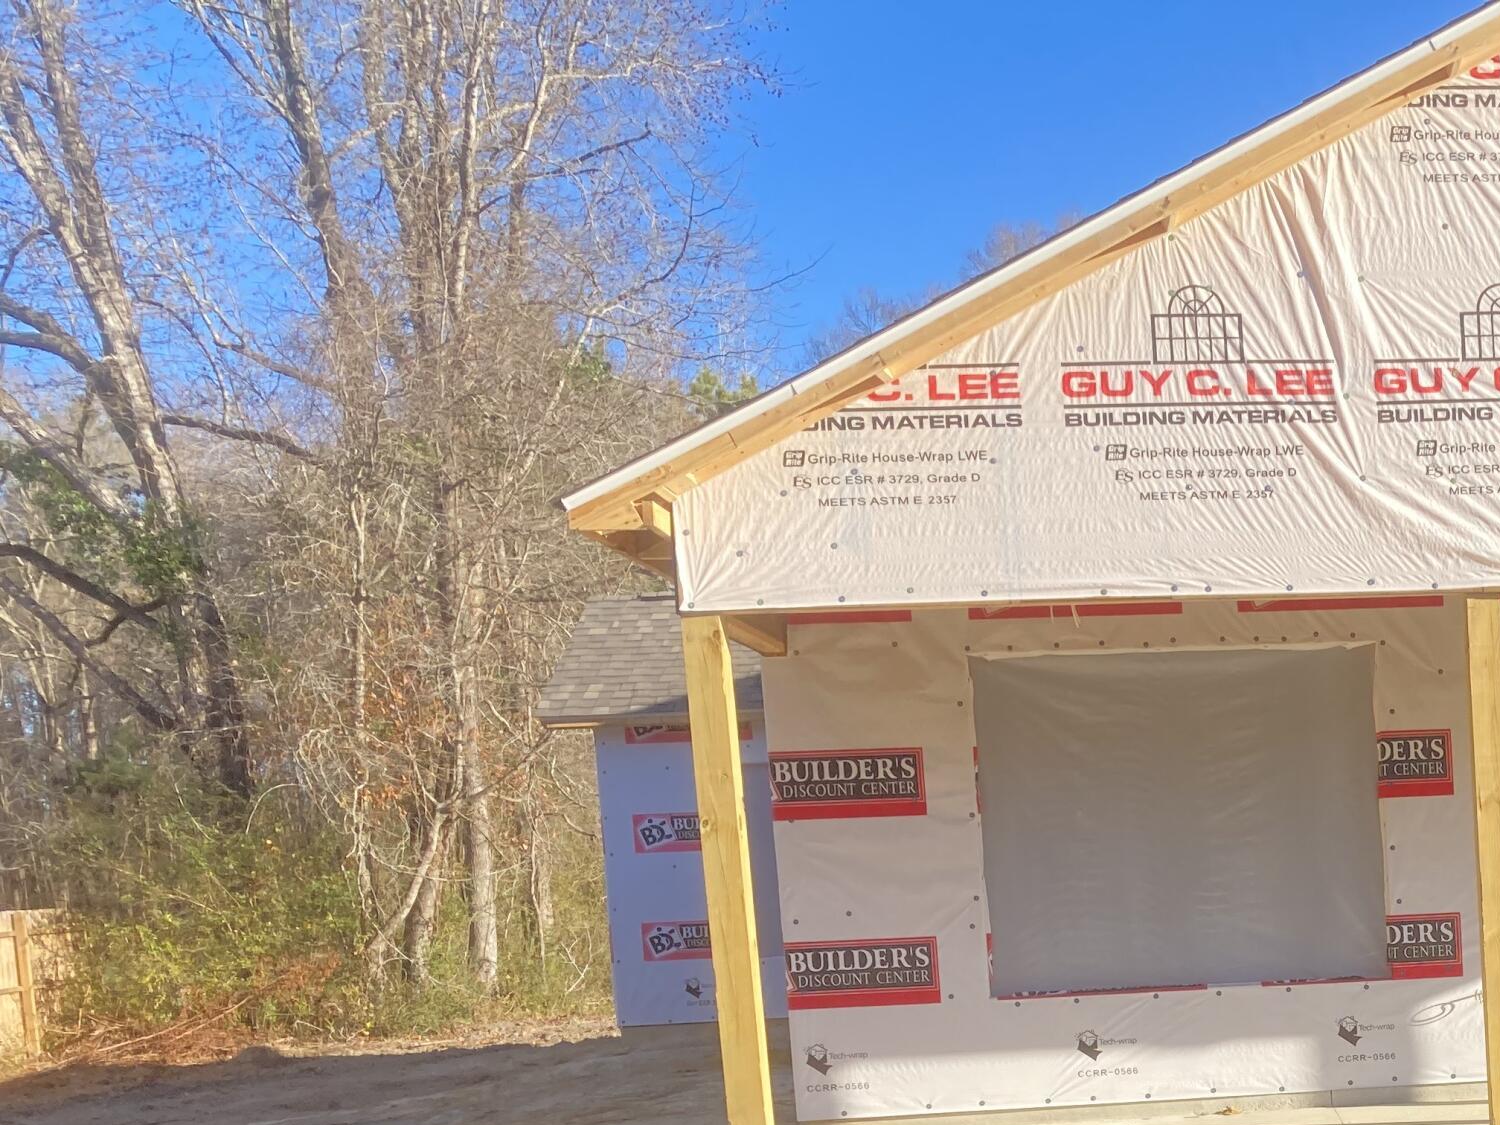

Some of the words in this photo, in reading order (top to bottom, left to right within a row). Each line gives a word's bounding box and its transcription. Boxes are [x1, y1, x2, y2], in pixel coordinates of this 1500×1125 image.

[1413, 130, 1470, 143] Grip-Rite
[1422, 152, 1445, 161] ICC
[1450, 152, 1475, 161] ESR
[1479, 152, 1487, 161] #
[928, 372, 1020, 401] LEE
[1061, 370, 1173, 398] GUY
[1186, 370, 1232, 397] C.
[1246, 369, 1335, 397] LEE
[1374, 366, 1480, 394] GUY
[872, 413, 1023, 430] MATERIALS
[1064, 410, 1186, 427] BUILDING
[1192, 409, 1338, 425] MATERIALS
[1377, 406, 1493, 424] BUILDING
[1130, 447, 1188, 460] Grip-Rite
[1192, 446, 1271, 459] House-Wrap
[1275, 444, 1304, 456] LWE
[1440, 443, 1496, 455] Grip-Rite
[807, 453, 868, 466] Grip-Rite
[873, 451, 953, 464] House-Wrap
[958, 450, 988, 461] LWE
[817, 475, 841, 485] ICC
[845, 475, 873, 485] ESR
[877, 475, 885, 484] #
[888, 474, 923, 486] 3729,
[927, 473, 967, 483] Grade
[971, 472, 981, 482] D
[818, 497, 866, 507] MEETS
[870, 496, 909, 506] ASTM
[914, 496, 922, 505] E
[928, 495, 957, 505] 2357
[774, 757, 916, 783] BUILDER'S
[1394, 762, 1445, 776] CENTER
[783, 783, 855, 799] DISCOUNT
[862, 781, 916, 796] CENTER
[789, 946, 930, 973] BUILDER'S
[1404, 945, 1454, 959] CENTER
[797, 972, 870, 988] DISCOUNT
[876, 970, 930, 984] CENTER
